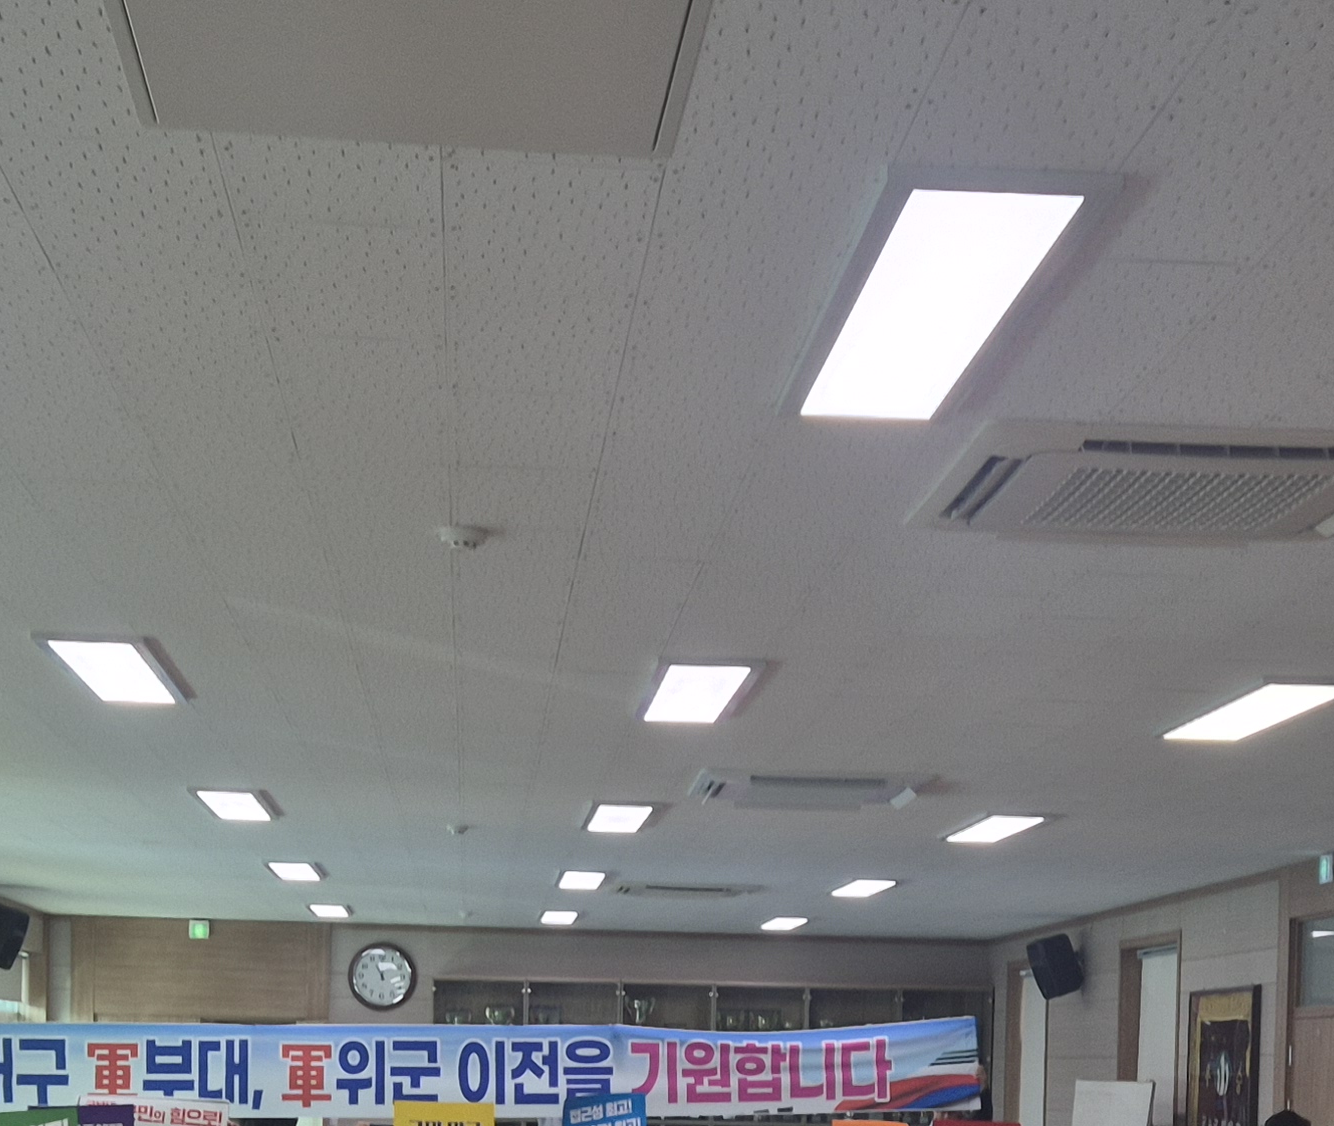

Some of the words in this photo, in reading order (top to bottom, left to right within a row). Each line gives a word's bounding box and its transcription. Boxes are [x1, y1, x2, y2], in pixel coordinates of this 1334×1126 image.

[280, 1039, 443, 1108] 軍위군
[457, 1040, 615, 1105] 이전을
[629, 1039, 894, 1104] 기원합니다
